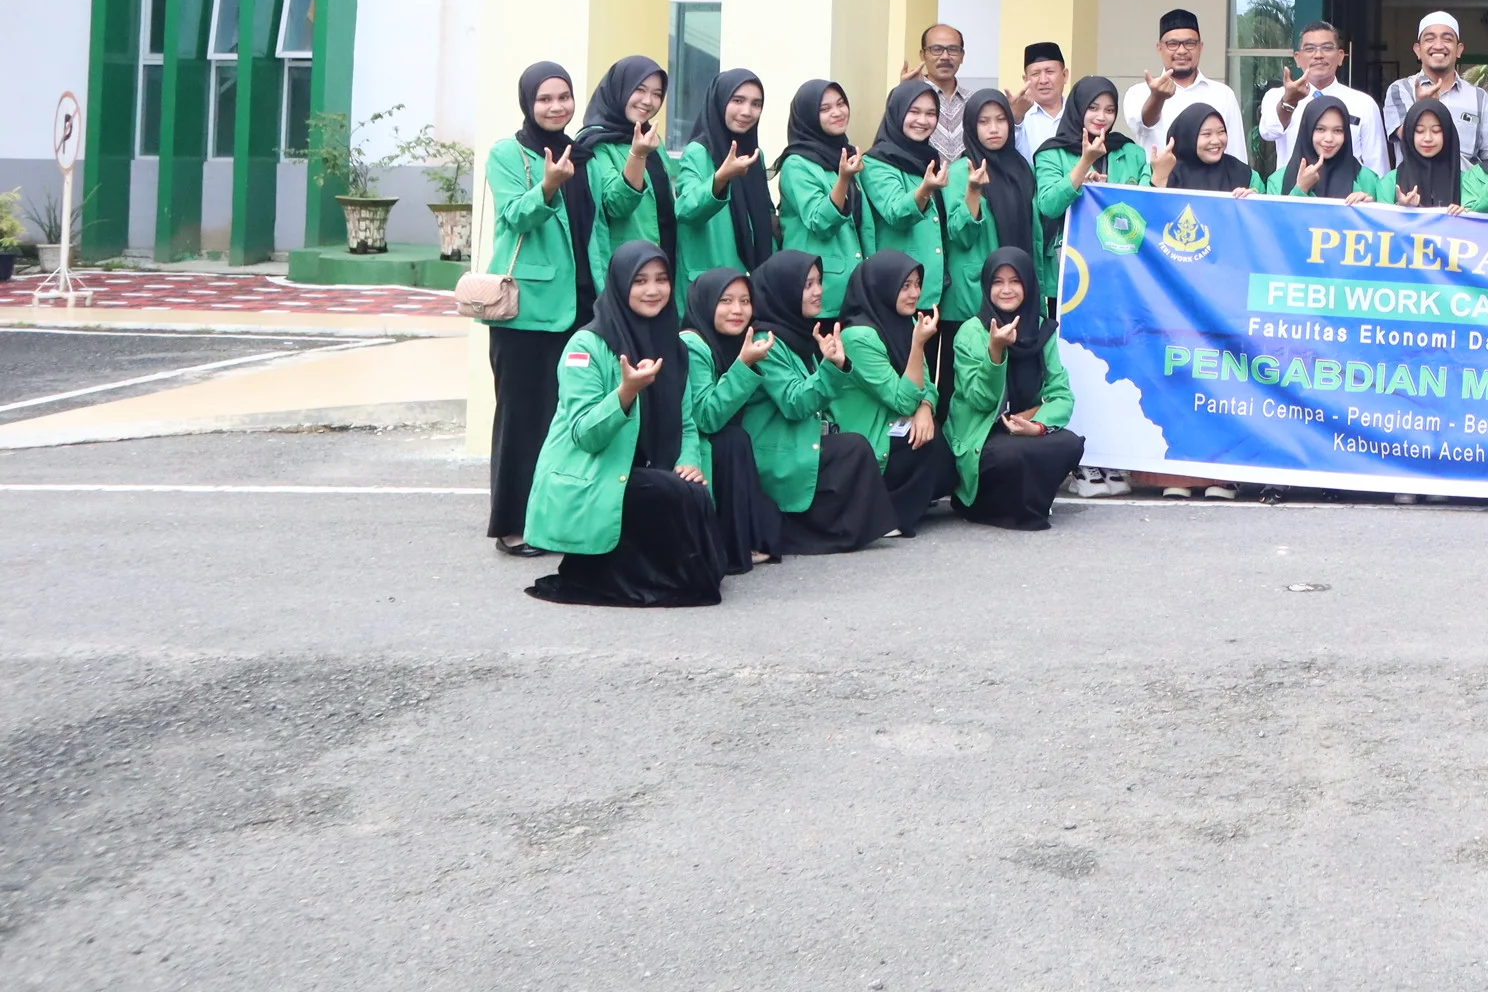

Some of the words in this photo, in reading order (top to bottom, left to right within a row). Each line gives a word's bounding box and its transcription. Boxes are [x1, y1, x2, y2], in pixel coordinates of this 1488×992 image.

[1158, 242, 1170, 256] FEBI
[1170, 253, 1193, 262] WORK
[1193, 245, 1211, 260] CAMP
[1268, 282, 1335, 310] FEBI
[1344, 287, 1441, 316] WORK
[1248, 317, 1347, 342] Fakultas
[1360, 325, 1456, 348] Ekonomi
[1164, 346, 1448, 398] PENGABDIAN
[1194, 393, 1253, 416] Pantai
[1262, 399, 1325, 423] Cempa
[1347, 409, 1441, 432] Pengidam
[1333, 432, 1431, 459] Kabupaten
[1439, 444, 1486, 462] Aceh
